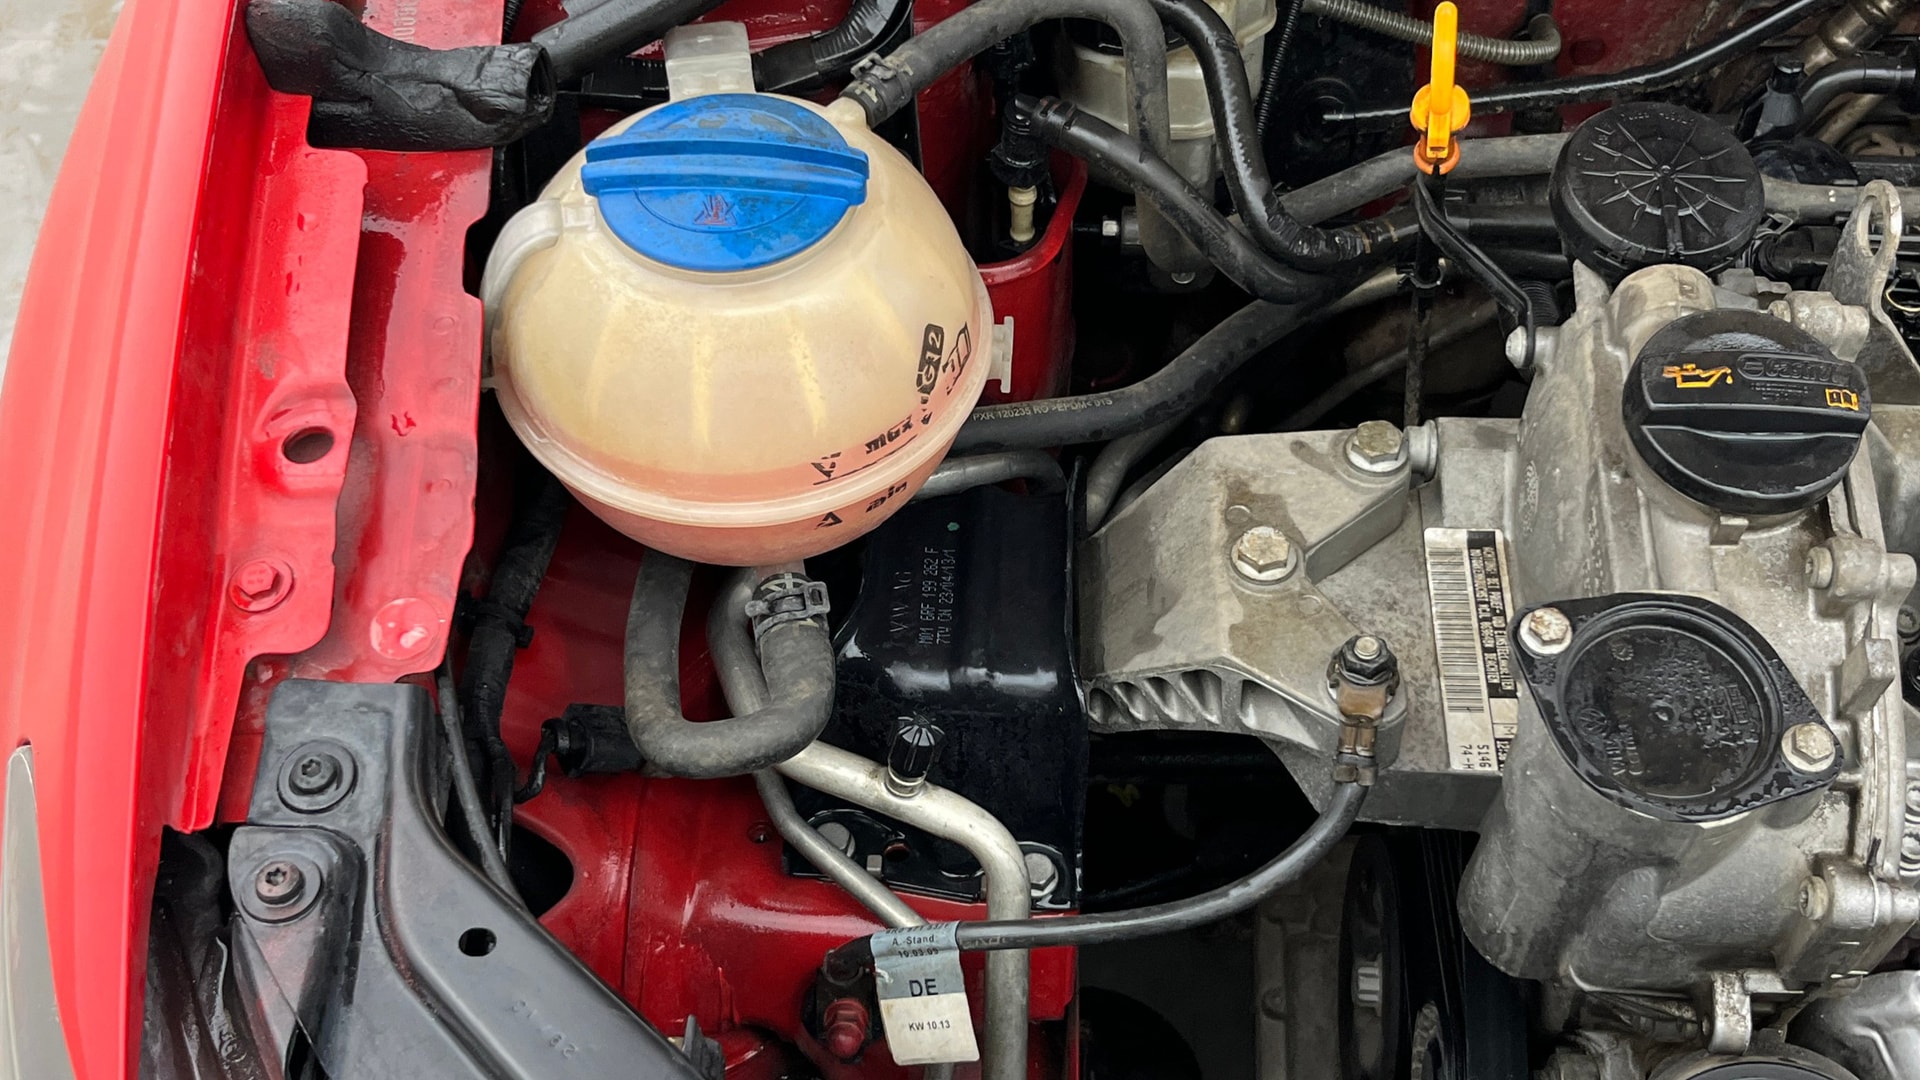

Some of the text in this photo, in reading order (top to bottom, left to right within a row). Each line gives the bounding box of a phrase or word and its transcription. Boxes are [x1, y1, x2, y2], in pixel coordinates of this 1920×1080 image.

[922, 330, 942, 385] G12
[998, 407, 1031, 419] 120235
[924, 546, 939, 554] F
[923, 558, 939, 576] 262
[922, 580, 937, 598] 199
[1477, 744, 1493, 768] 5146
[909, 978, 939, 997] DE
[908, 1019, 951, 1031] KW 10.13
